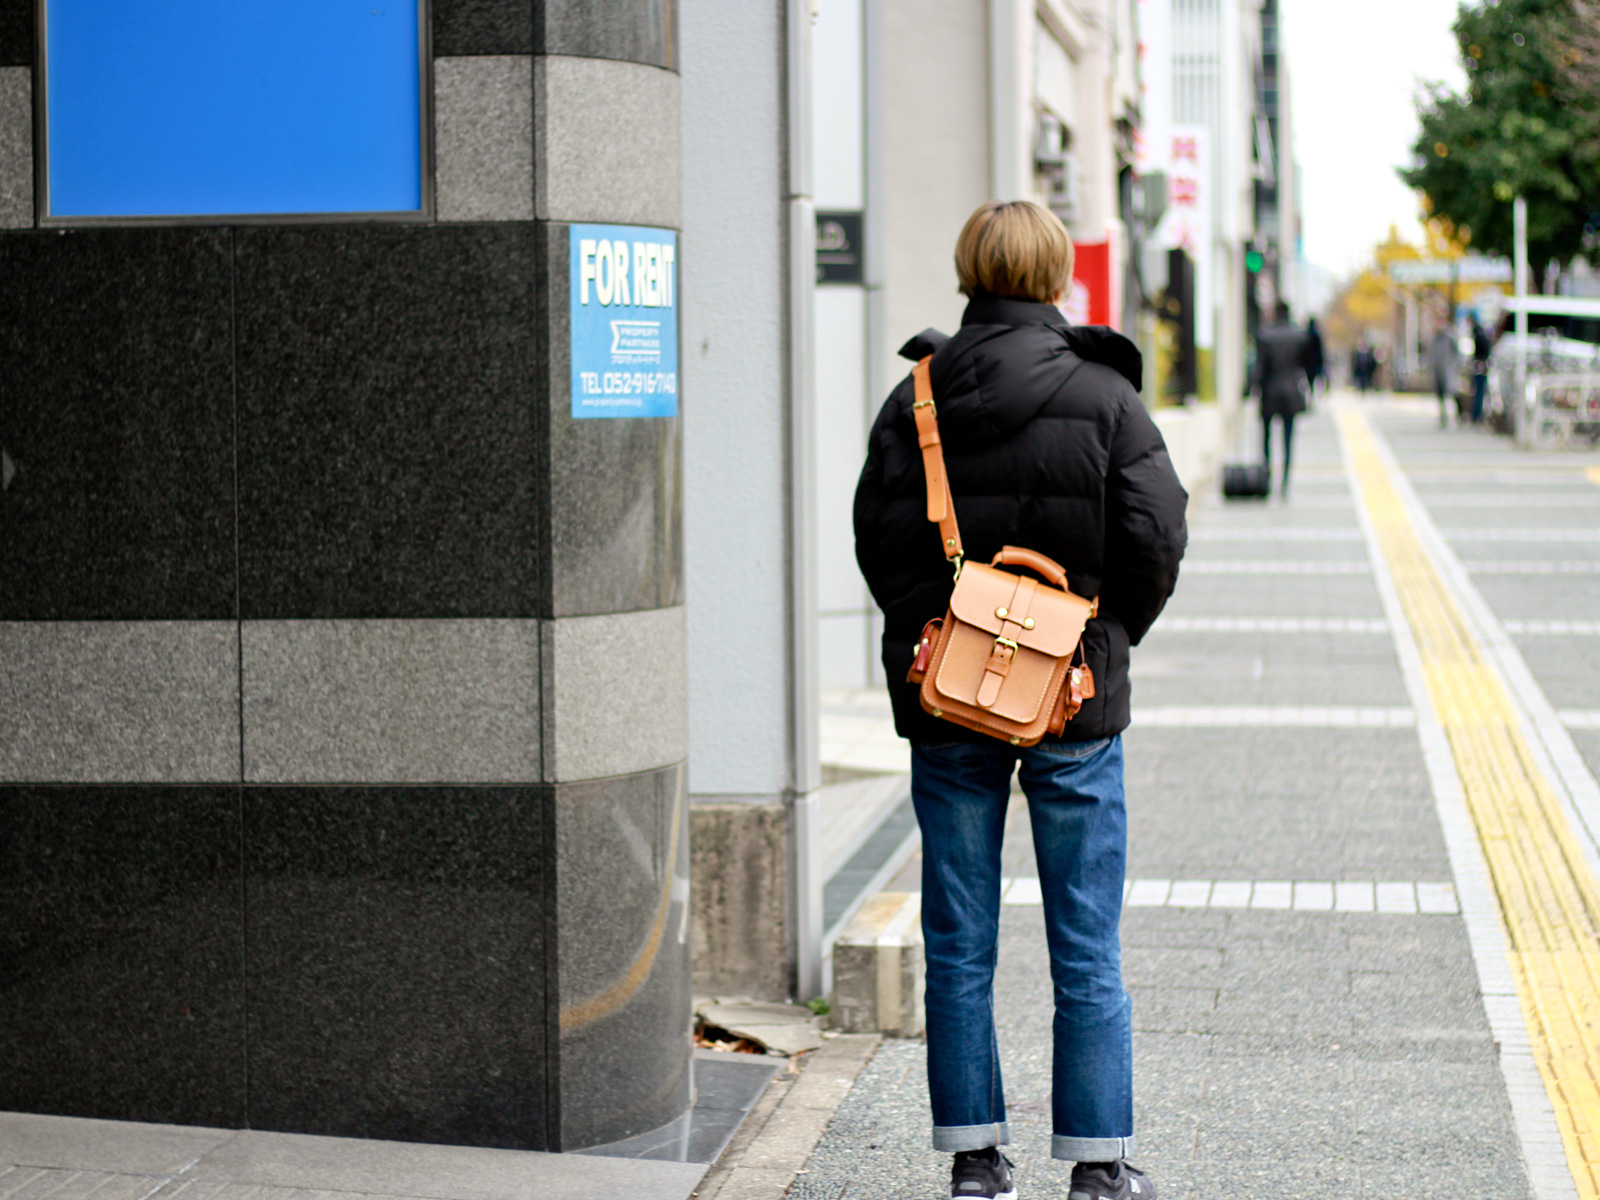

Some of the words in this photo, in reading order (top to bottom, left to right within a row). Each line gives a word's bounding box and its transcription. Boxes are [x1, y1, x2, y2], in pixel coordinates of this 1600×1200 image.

[580, 239, 630, 307] FOR
[633, 242, 674, 308] RENT
[621, 328, 659, 337] PROPERTY
[621, 339, 660, 348] PARTNERS
[580, 372, 602, 394] TEL
